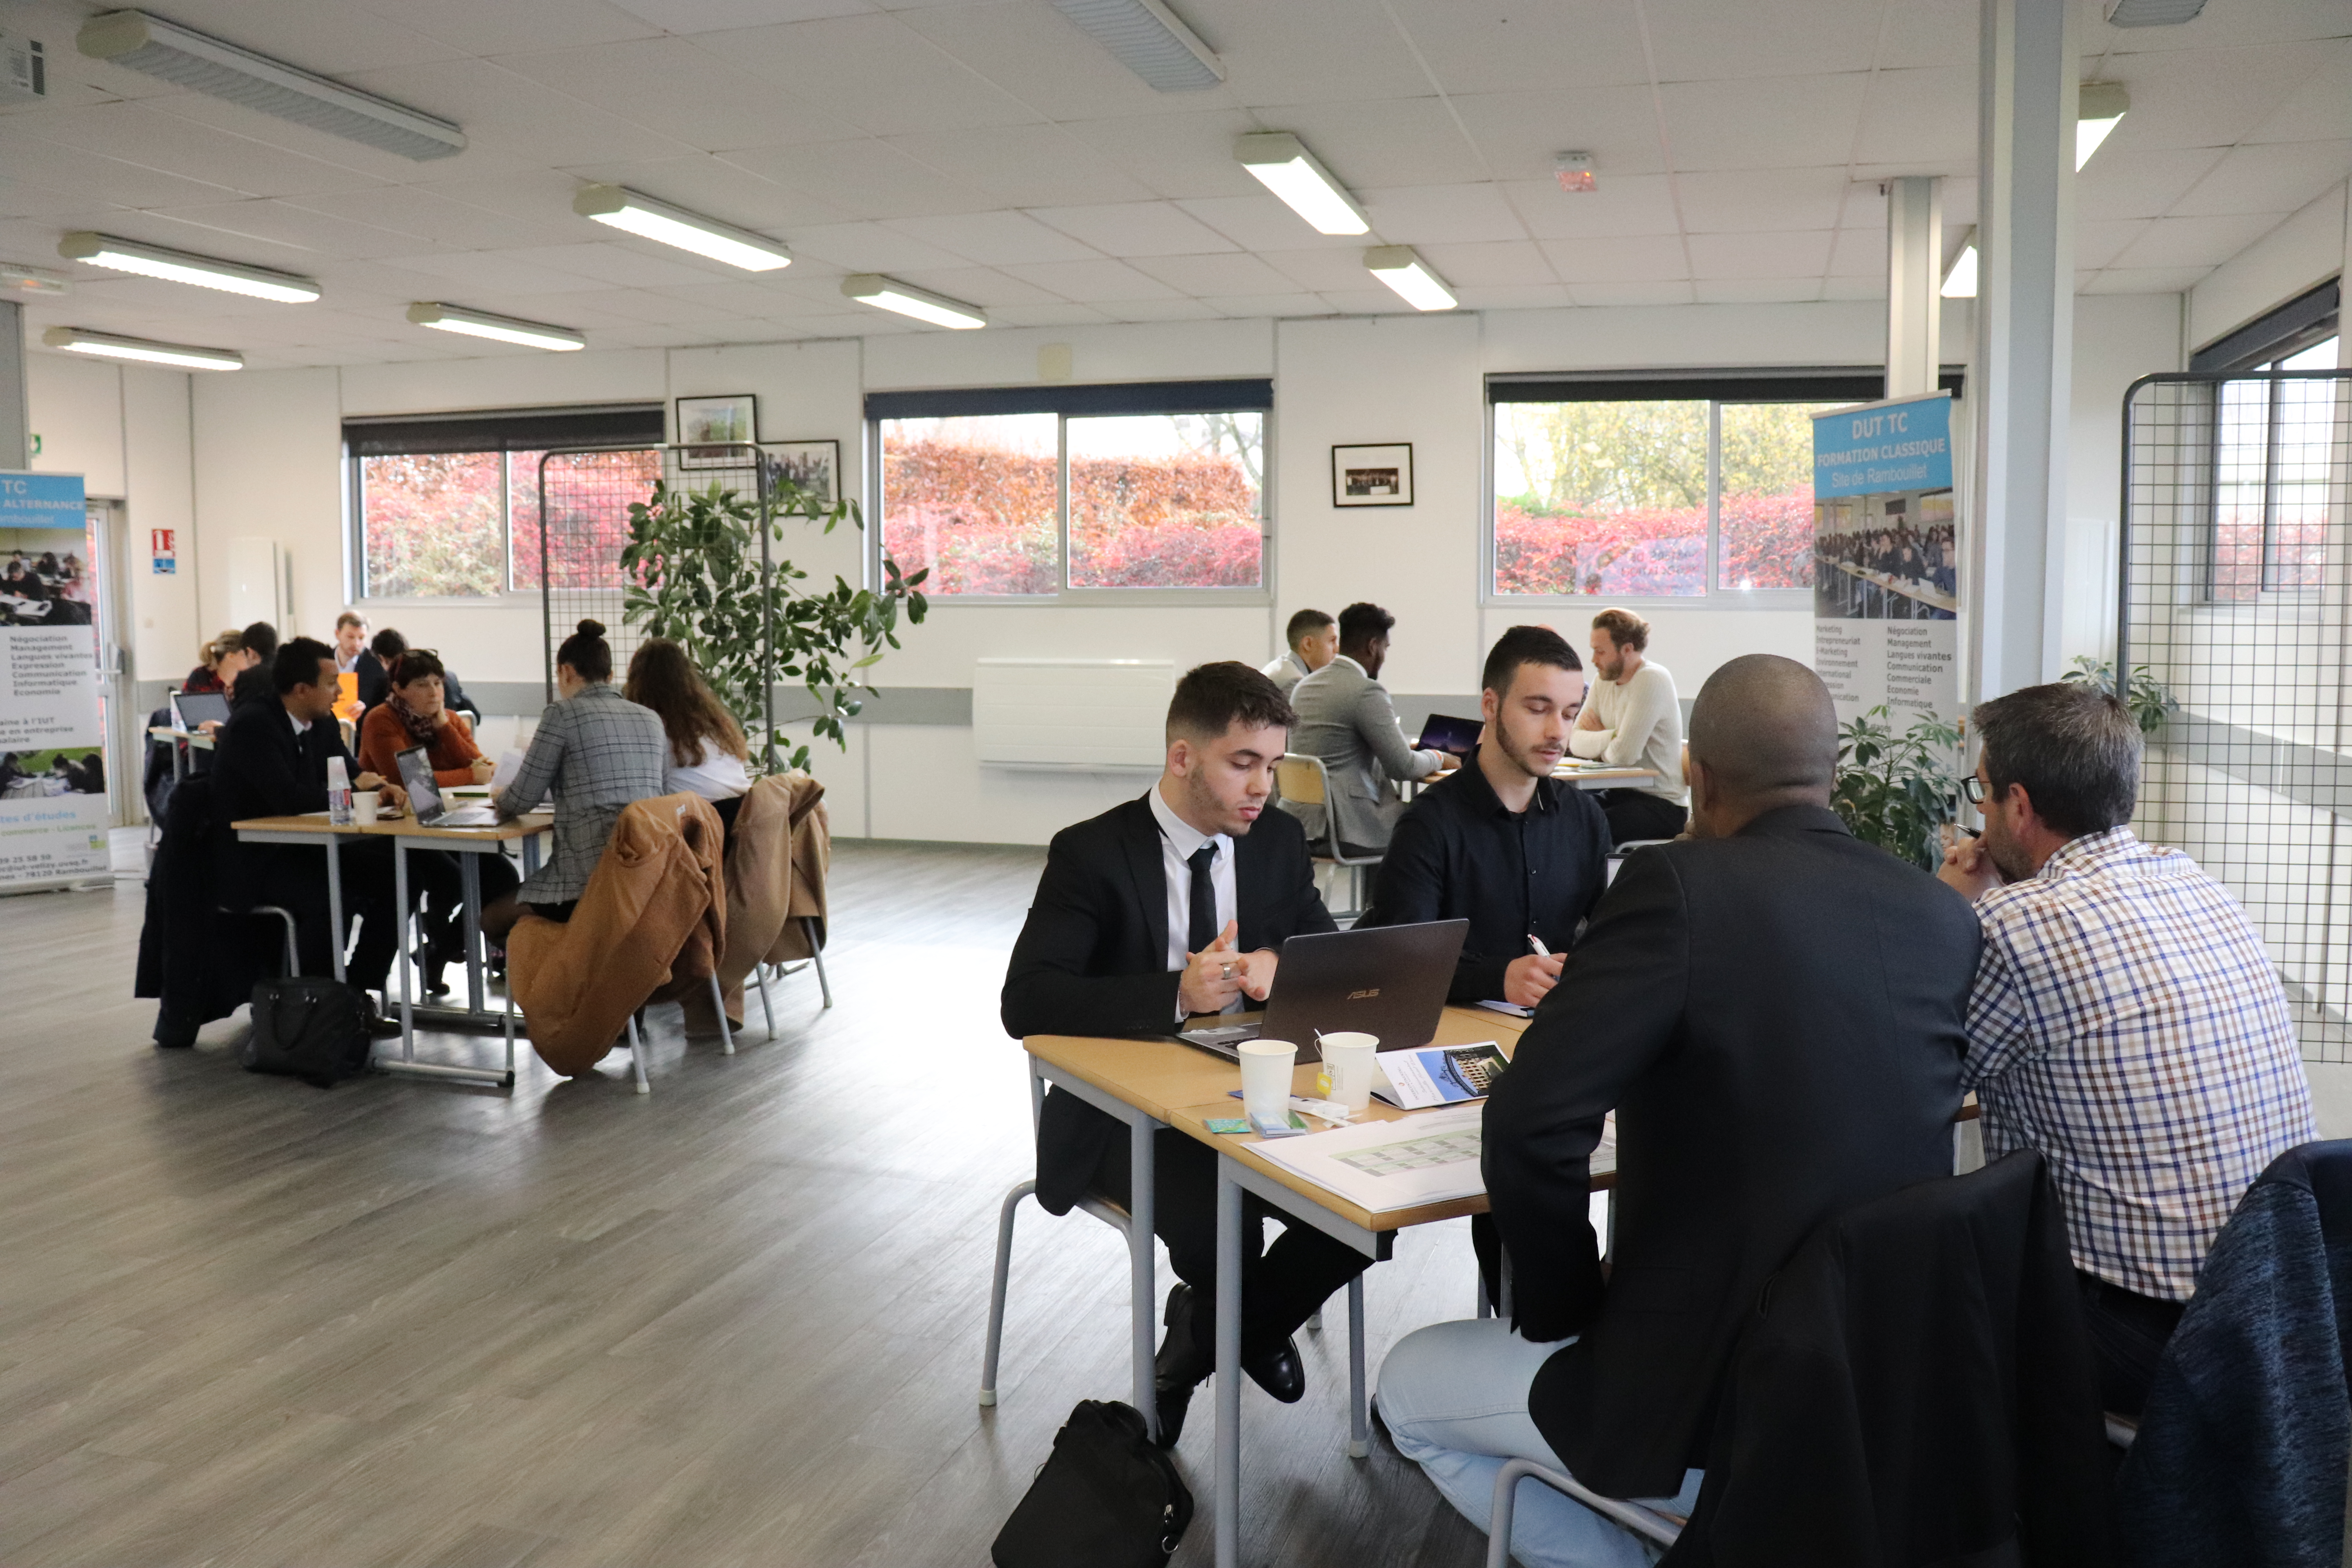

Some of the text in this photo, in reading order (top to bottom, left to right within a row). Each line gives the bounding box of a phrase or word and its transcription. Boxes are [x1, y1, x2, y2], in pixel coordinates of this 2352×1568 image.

[1853, 412, 1908, 439] DUT TC
[1817, 438, 1945, 467] FORMATION CLASSIQUE
[1832, 463, 1927, 488] Site de Rambouillet
[2, 479, 27, 494] TC
[4, 499, 84, 510] ALTERNANCE
[1887, 626, 1928, 637] Négociation
[1887, 639, 1932, 648] Management
[1887, 650, 1952, 661] Langues vivantes
[1887, 662, 1943, 673] Communication
[1887, 674, 1932, 684] Commerciale
[1887, 685, 1919, 695] Economie
[1887, 697, 1933, 708] Informatique
[1348, 989, 1379, 1000] ASUS
